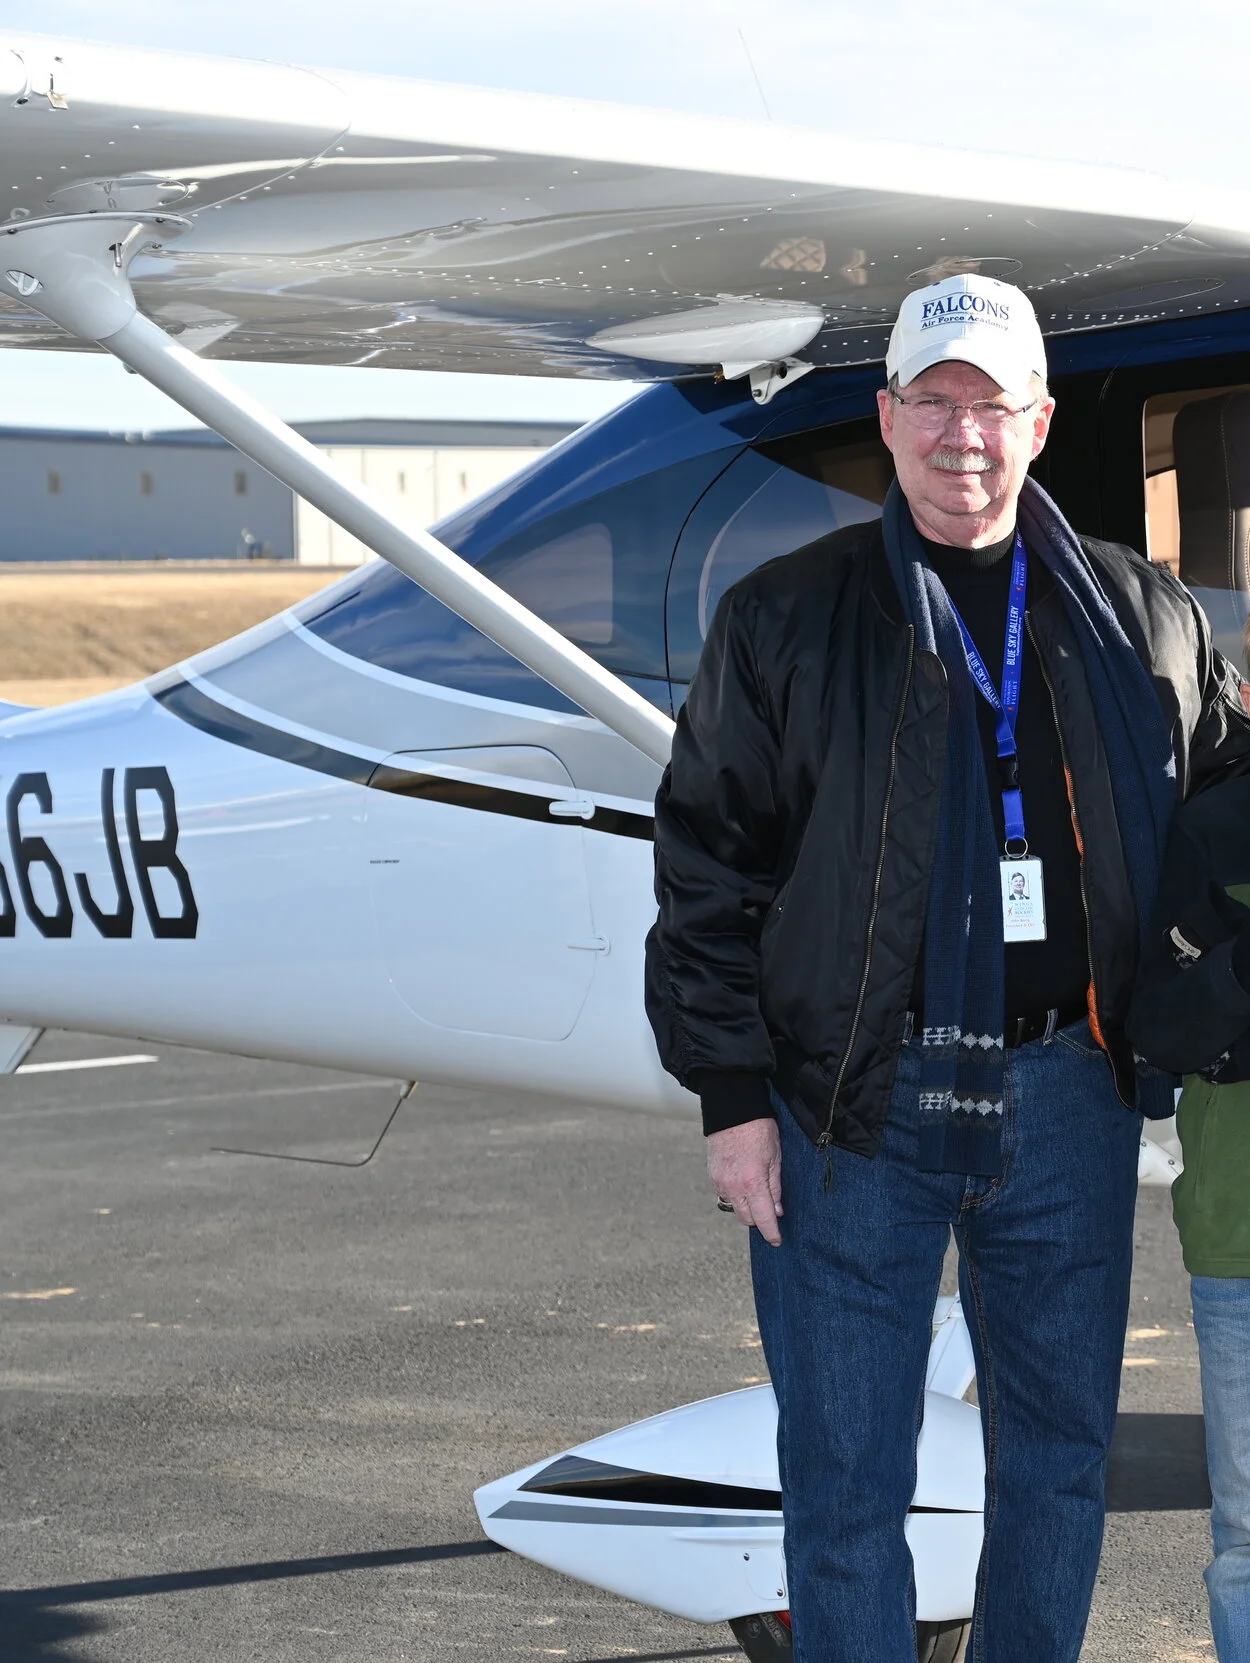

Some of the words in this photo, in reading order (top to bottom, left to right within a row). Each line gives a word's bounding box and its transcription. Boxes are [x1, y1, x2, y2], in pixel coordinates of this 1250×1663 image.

[922, 294, 1010, 320] FALCONS
[922, 320, 935, 328] Air
[938, 316, 965, 325] Force
[1009, 605, 1019, 634] GALLERY
[1008, 634, 1016, 648] SKY
[967, 651, 981, 670] BLUE
[975, 668, 987, 682] SKY
[1007, 648, 1016, 666] BLUE
